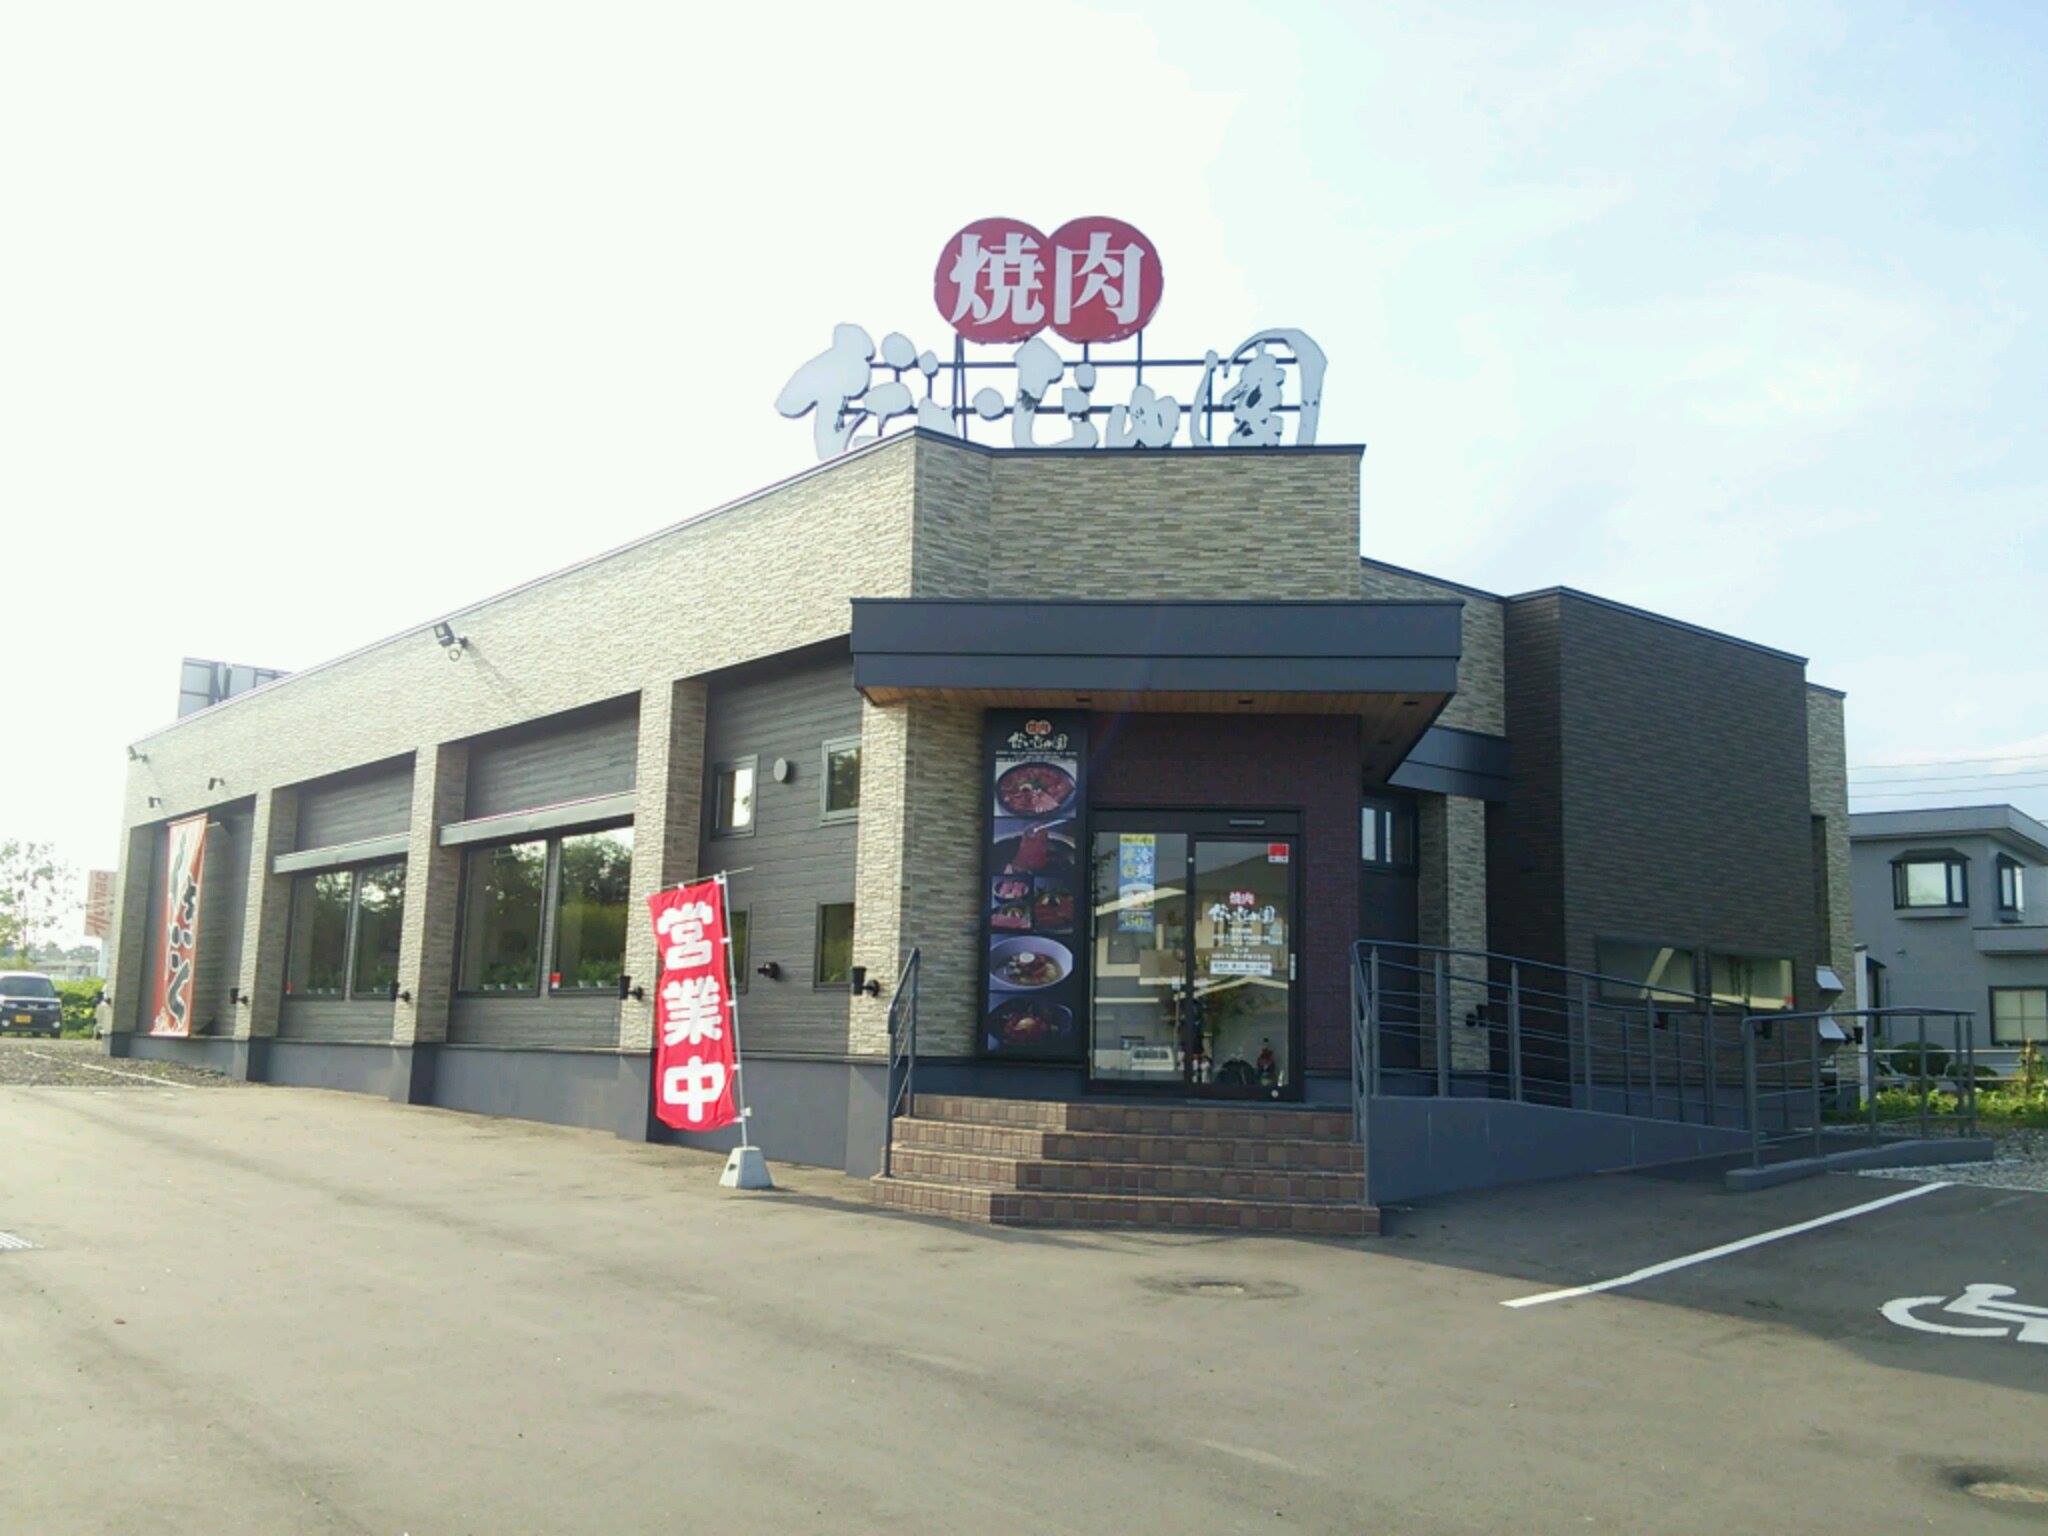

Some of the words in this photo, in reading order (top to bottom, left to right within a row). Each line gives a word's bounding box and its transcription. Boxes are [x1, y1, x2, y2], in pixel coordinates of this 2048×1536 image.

[949, 231, 1146, 326] 焼肉
[656, 900, 725, 1123] 営業中
